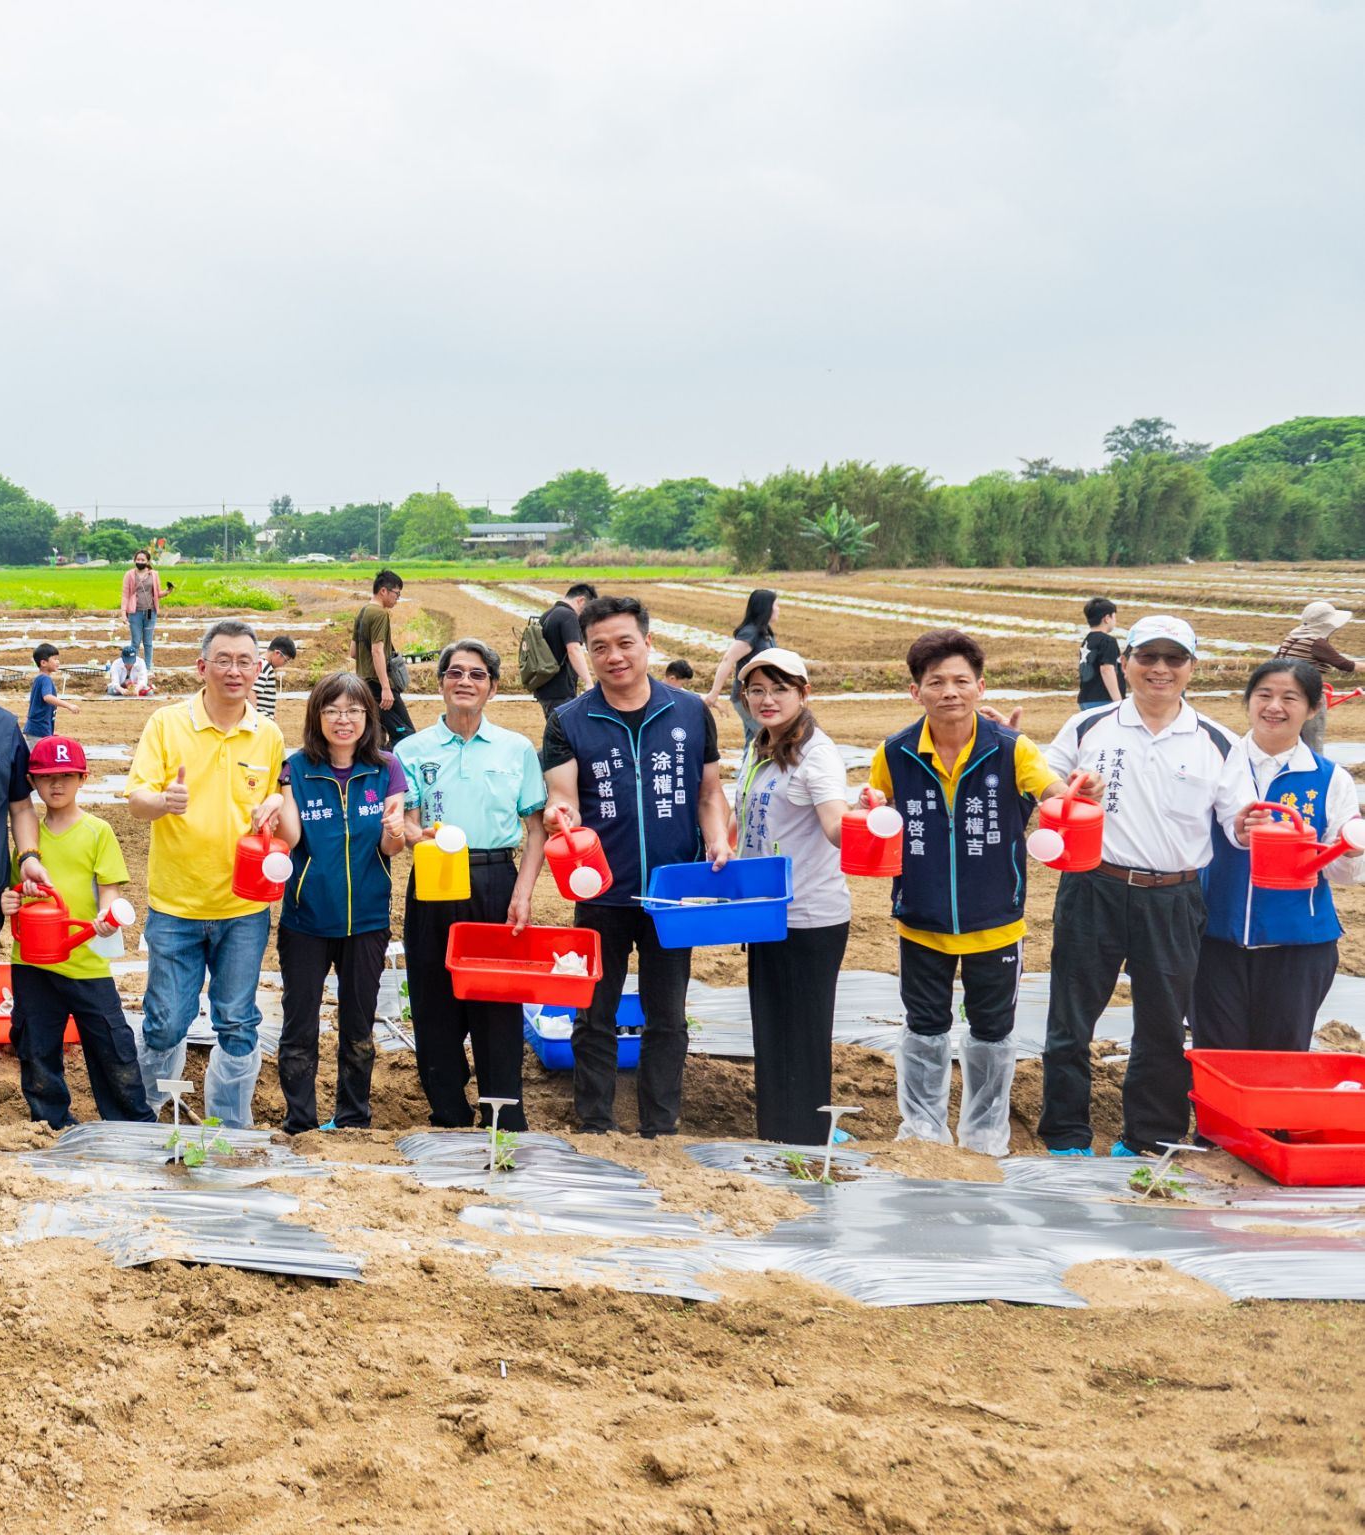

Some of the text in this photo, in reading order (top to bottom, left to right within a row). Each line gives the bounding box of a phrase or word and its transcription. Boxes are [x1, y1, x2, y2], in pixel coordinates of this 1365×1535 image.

[56, 744, 71, 762] R
[611, 747, 623, 768] 主任
[676, 742, 685, 788] 立法委員
[592, 760, 617, 819] 劉銘翔
[651, 751, 673, 819] 涂權吉
[925, 790, 937, 810] 秘書
[965, 796, 984, 856] 涂權吉
[987, 789, 999, 829] 立法委員
